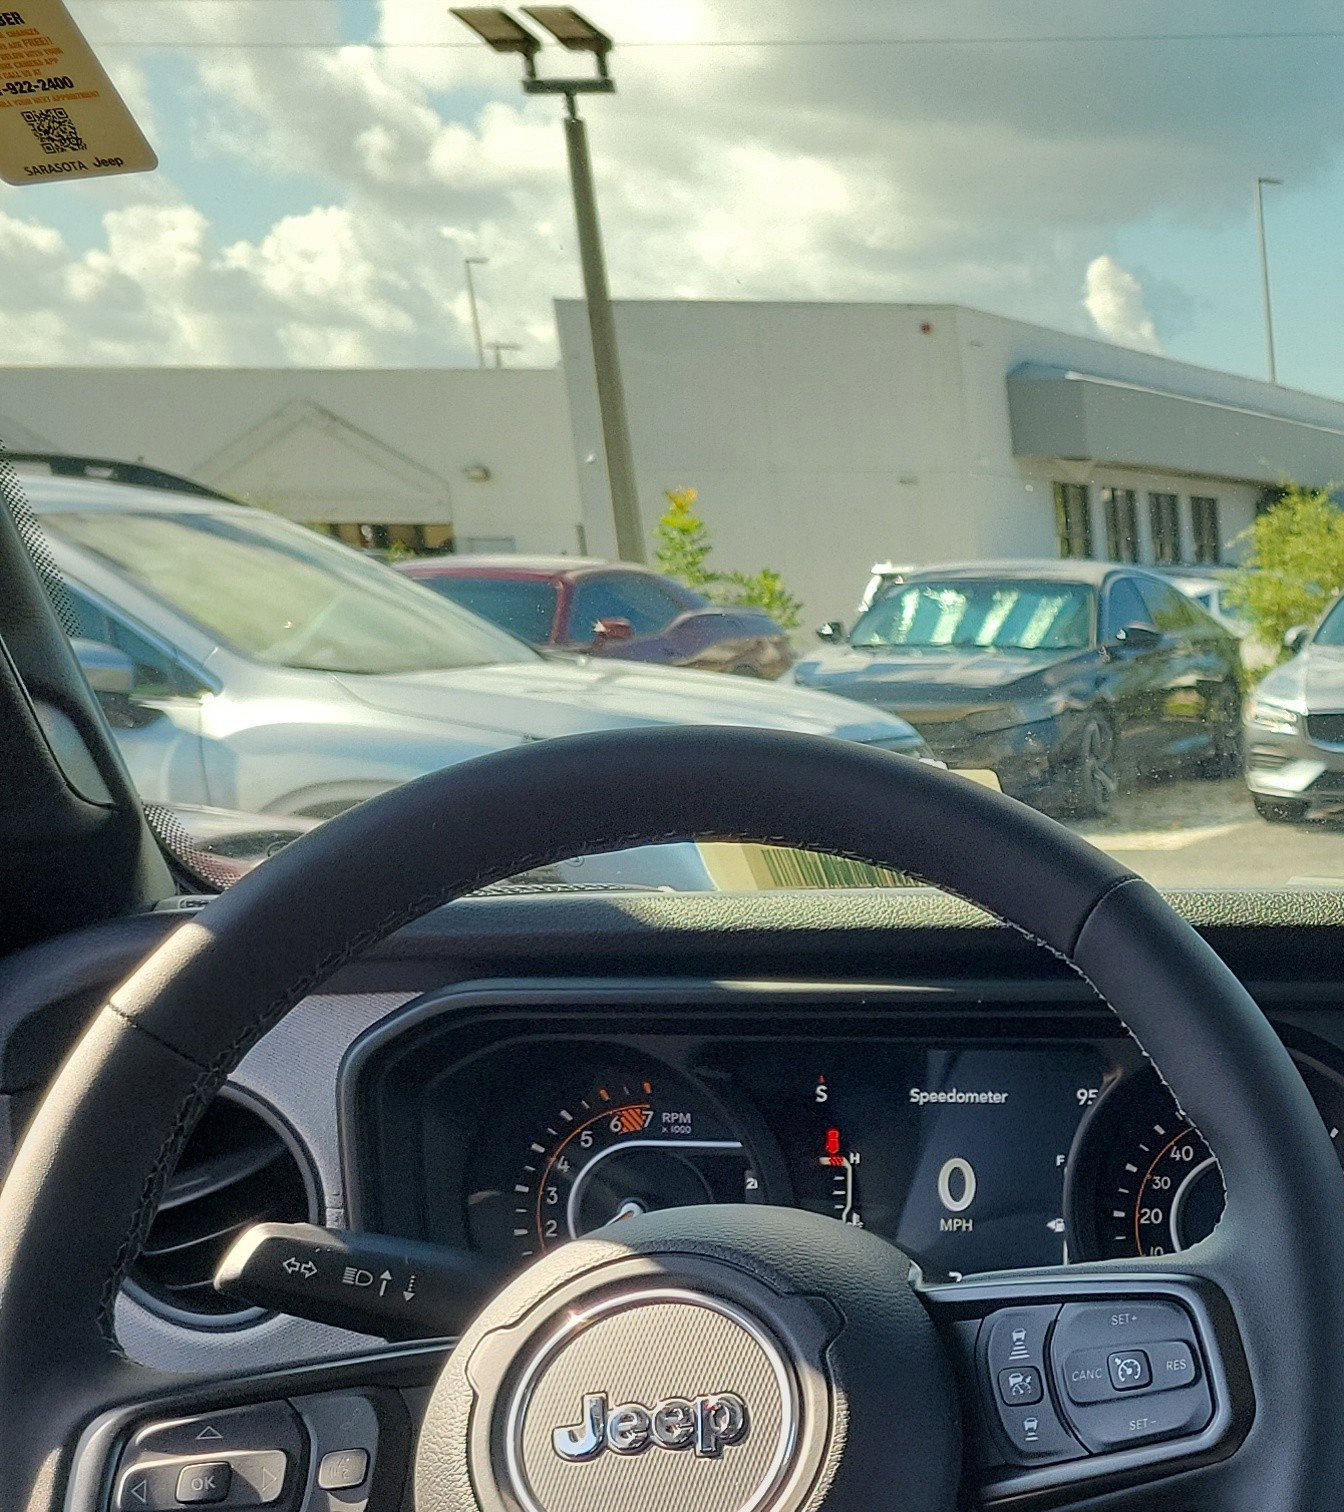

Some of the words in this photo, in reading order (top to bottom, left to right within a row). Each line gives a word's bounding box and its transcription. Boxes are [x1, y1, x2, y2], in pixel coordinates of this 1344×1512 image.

[24, 160, 88, 177] SARASOTA
[93, 157, 124, 169] Jeep
[815, 1085, 828, 1102] S
[910, 1088, 1008, 1105] Speedometer
[609, 1115, 622, 1132] 6
[641, 1111, 654, 1128] 7
[662, 1112, 692, 1124] RPM
[580, 1131, 593, 1148] 5
[849, 1152, 861, 1165] H
[1055, 1154, 1065, 1167] F
[1170, 1144, 1194, 1162] 40
[557, 1155, 571, 1174] 4
[937, 1156, 977, 1212] 0
[1151, 1175, 1171, 1190] 30
[546, 1187, 558, 1204] 3
[939, 1217, 973, 1232] MPH
[1139, 1208, 1163, 1224] 20
[545, 1220, 558, 1237] 2
[1071, 1367, 1103, 1381] CANC
[1166, 1358, 1187, 1371] RES
[552, 1391, 751, 1462] Jeep
[190, 1476, 215, 1491] OK
